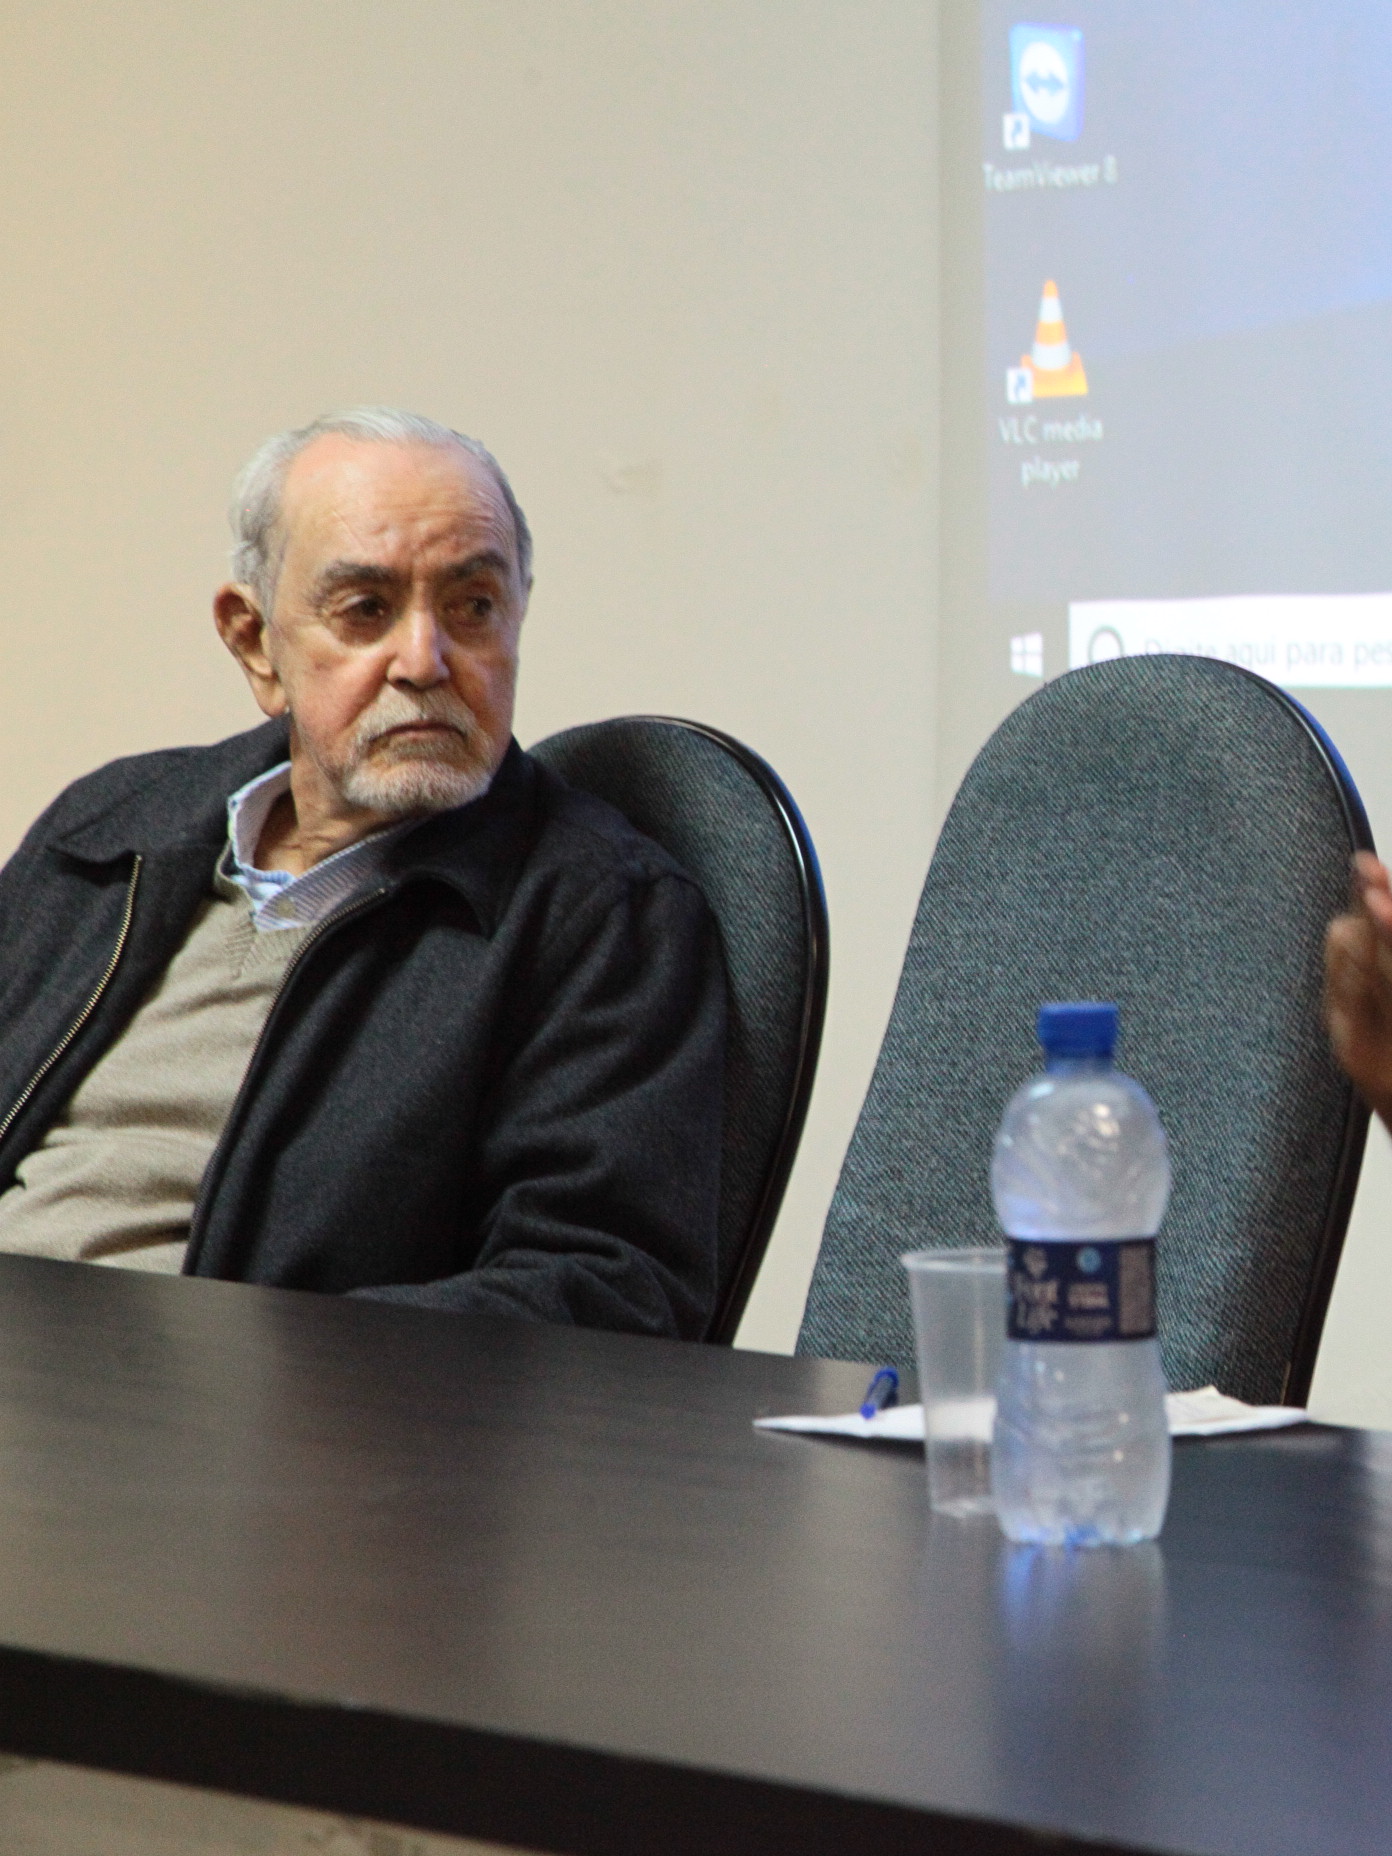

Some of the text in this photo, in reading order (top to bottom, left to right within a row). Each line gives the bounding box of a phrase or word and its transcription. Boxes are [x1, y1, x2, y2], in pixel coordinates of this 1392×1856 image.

[998, 412, 1104, 445] VLC media
[1020, 455, 1080, 488] player
[1225, 633, 1276, 670] aqui
[1285, 640, 1344, 671] para
